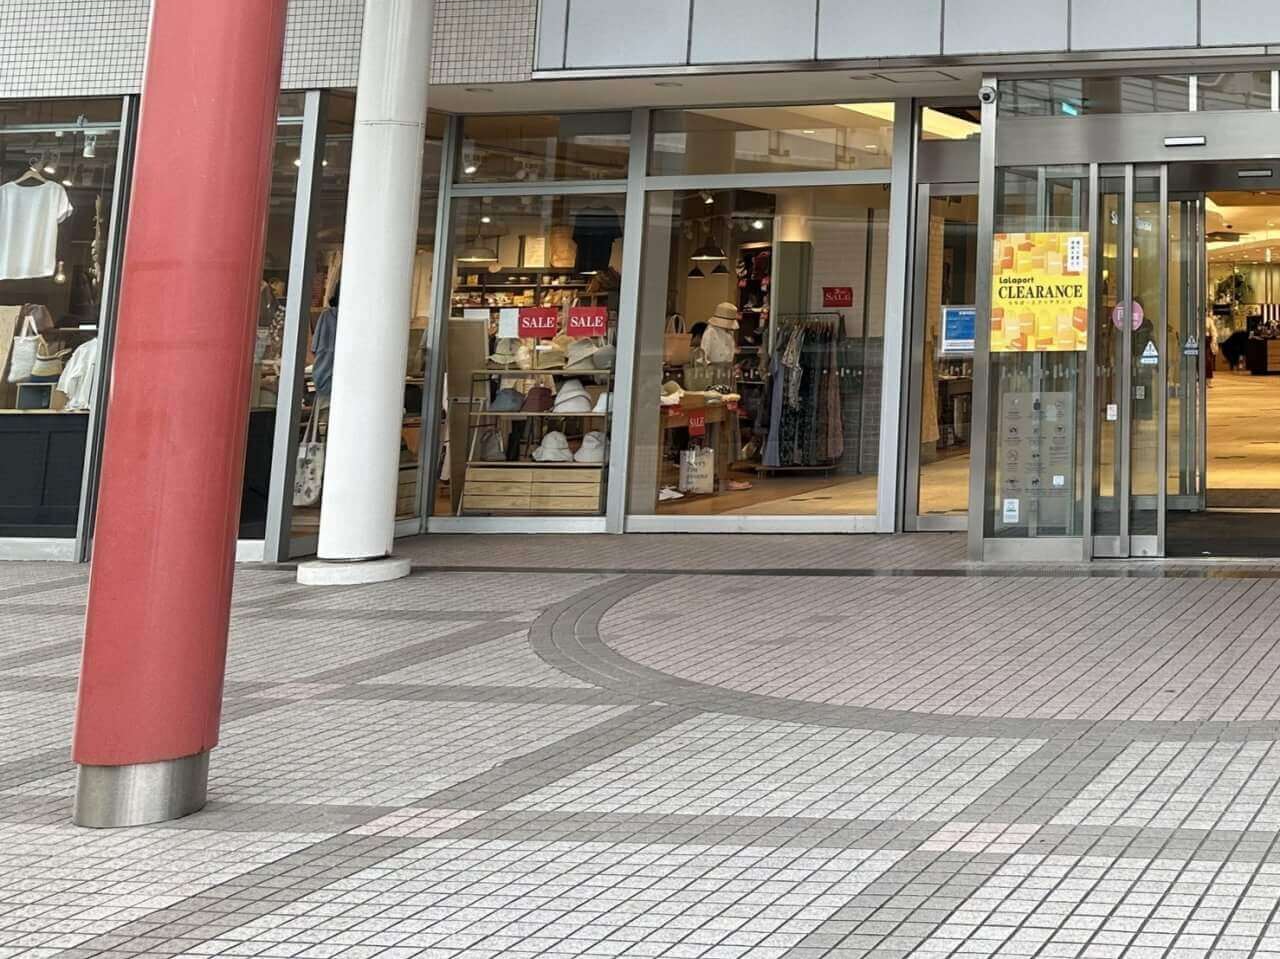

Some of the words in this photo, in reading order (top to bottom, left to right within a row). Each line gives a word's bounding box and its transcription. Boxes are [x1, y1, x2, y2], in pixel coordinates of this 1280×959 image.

[999, 276, 1035, 284] LaLaport
[998, 285, 1083, 299] CLEARANCE
[522, 317, 555, 329] SALE
[570, 315, 604, 328] SALE
